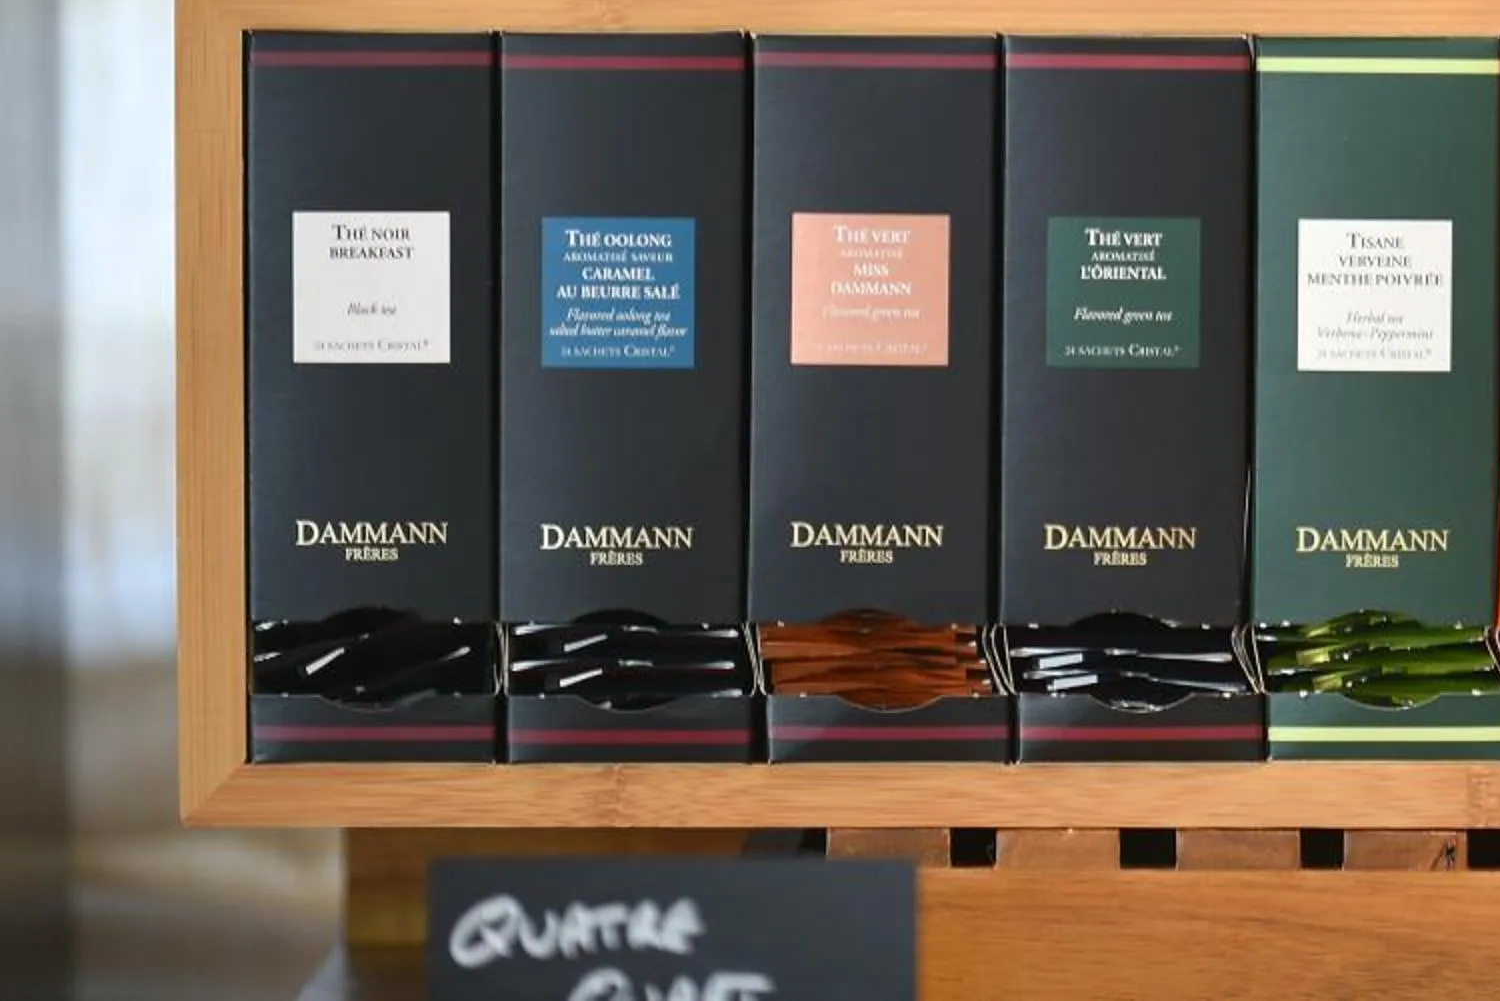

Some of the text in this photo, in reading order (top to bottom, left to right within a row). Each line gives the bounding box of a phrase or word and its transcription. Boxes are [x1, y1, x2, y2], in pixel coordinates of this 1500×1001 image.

[371, 227, 411, 241] NOIR
[565, 229, 672, 247] THÉ OOLONG
[871, 229, 911, 243] VERT
[1084, 227, 1163, 246] THÉ VERT
[1346, 232, 1404, 249] TISANE
[329, 246, 414, 260] BREAKFAST
[853, 263, 889, 276] MISS
[1339, 255, 1412, 268] VERVEINE
[581, 267, 655, 281] CARAMEL
[1307, 271, 1444, 287] MENTHE POIVRÉE
[556, 283, 681, 299] AU BEURRE SALÉ
[830, 281, 912, 296] DAMMANN
[296, 519, 448, 546] DAMMANN
[540, 523, 693, 550] DAMMANN
[791, 521, 944, 548] DAMMANN
[1044, 524, 1197, 550] DAMMANN
[1296, 526, 1450, 552] DAMMANN
